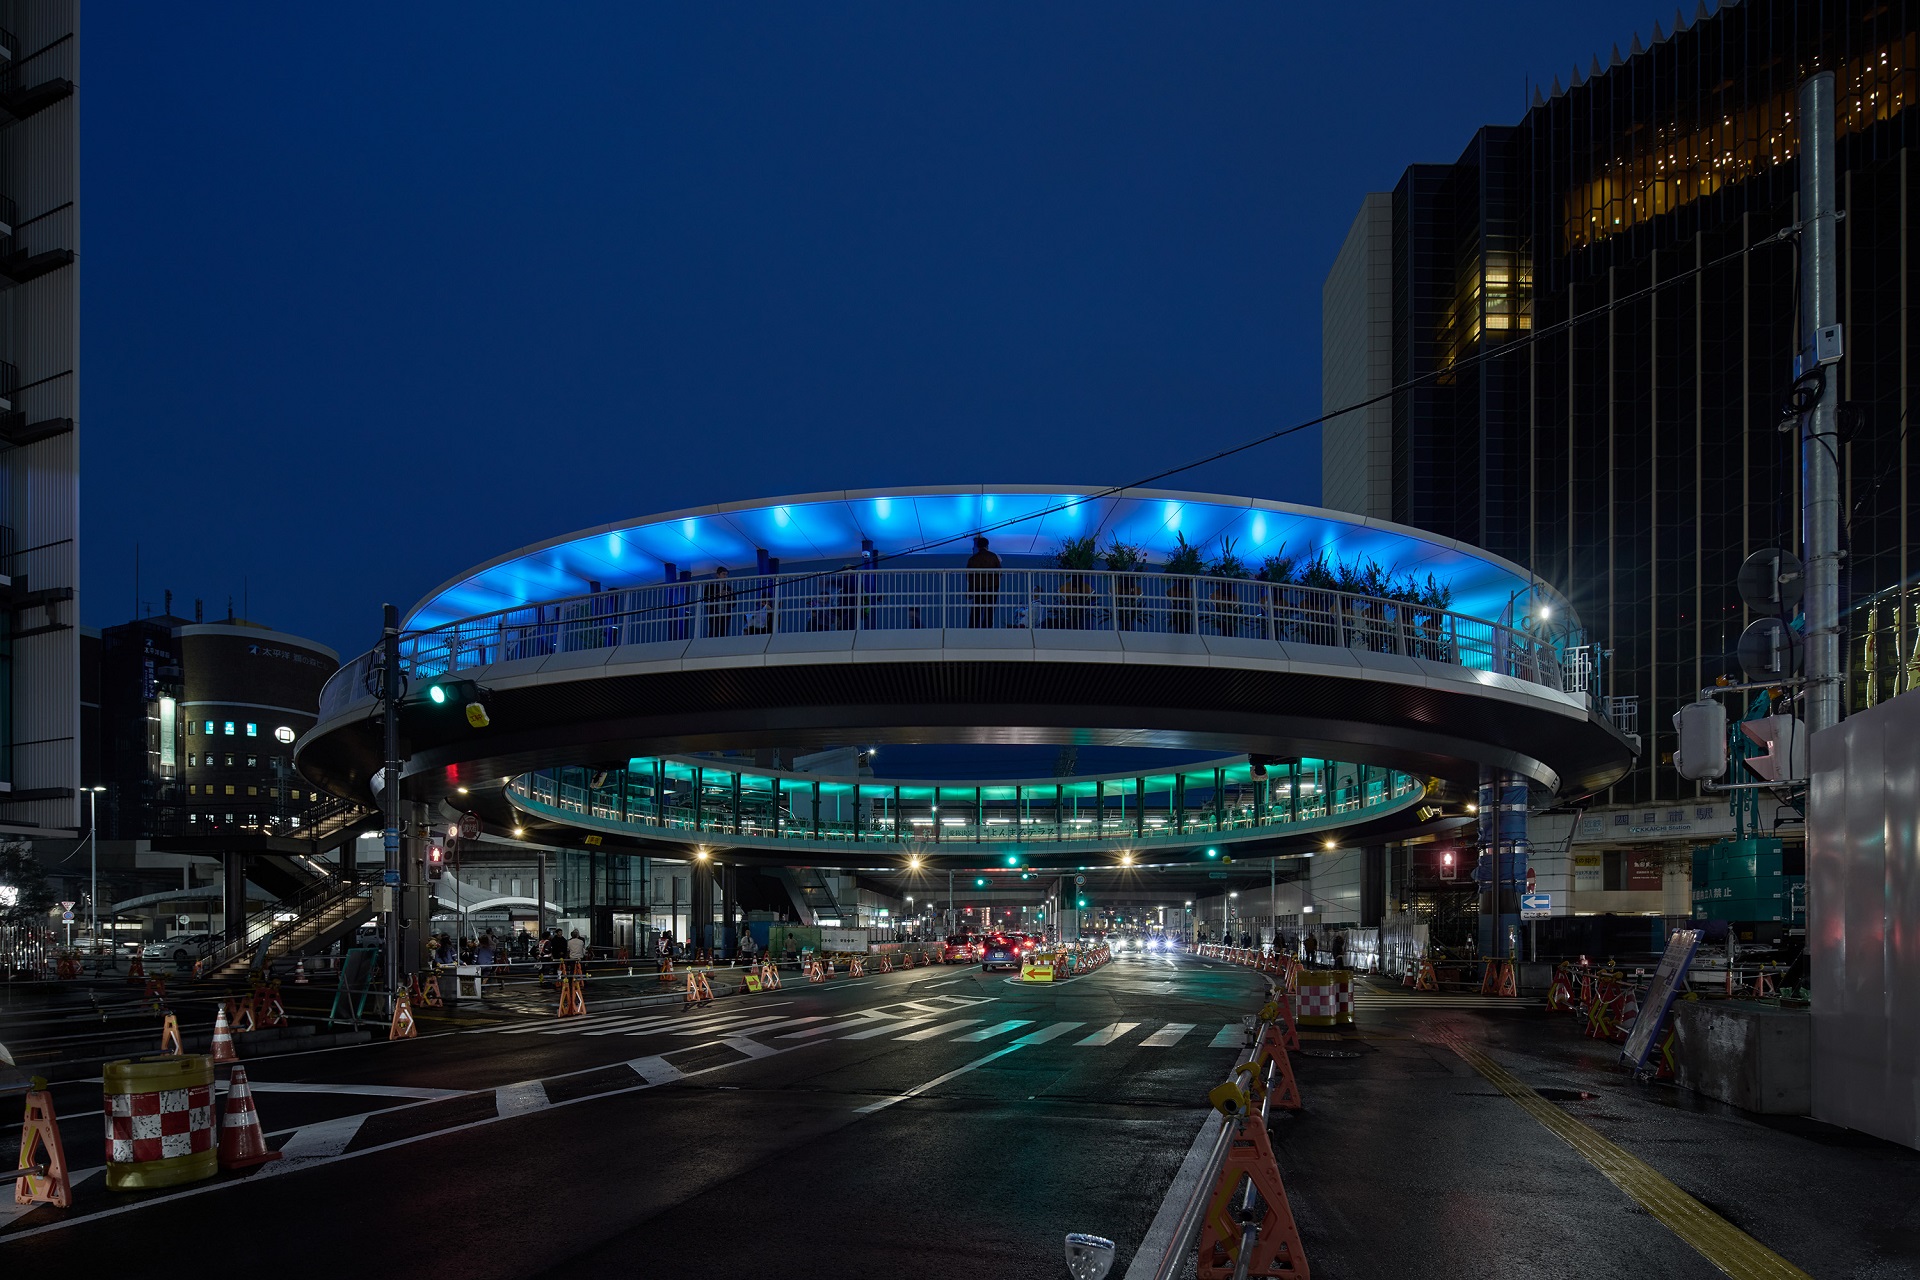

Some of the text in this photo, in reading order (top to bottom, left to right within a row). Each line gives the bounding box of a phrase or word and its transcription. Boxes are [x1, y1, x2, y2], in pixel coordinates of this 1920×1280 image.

[262, 647, 290, 660] 太平洋
[1614, 807, 1713, 826] 四日市駅
[1668, 823, 1691, 831] Station
